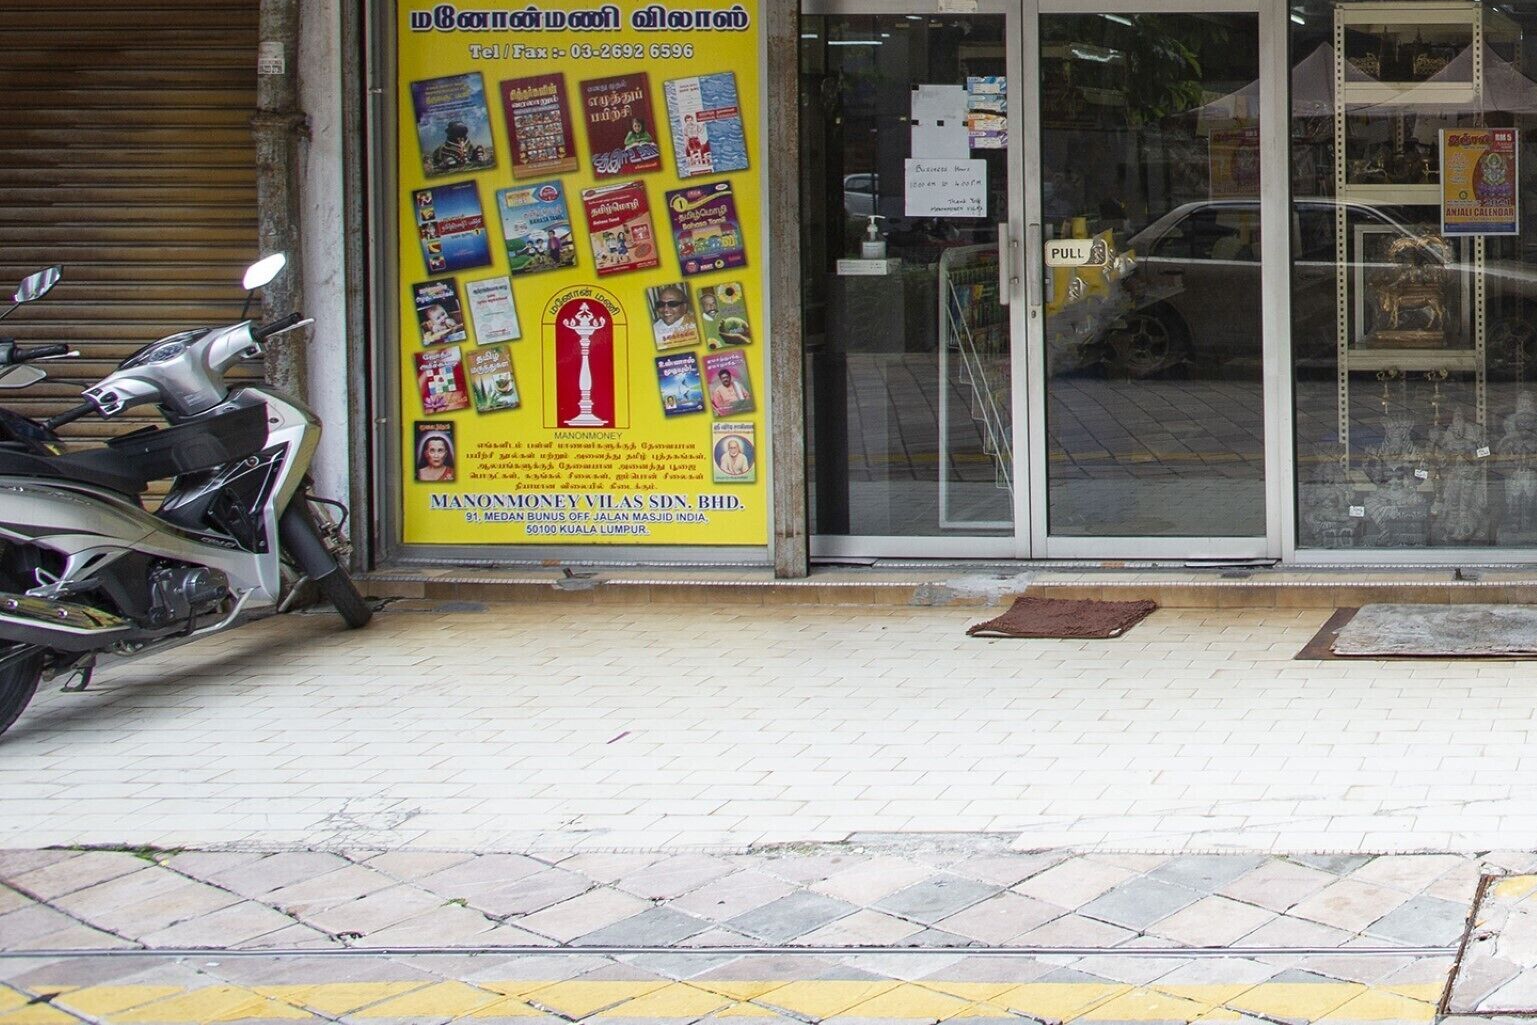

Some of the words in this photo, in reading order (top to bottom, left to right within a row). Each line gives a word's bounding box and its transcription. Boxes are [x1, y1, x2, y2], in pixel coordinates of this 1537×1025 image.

[410, 4, 621, 32] மனோன்மணி
[632, 4, 751, 32] விலாஸ்
[469, 44, 499, 59] Tel
[513, 44, 550, 59] Fax
[570, 44, 644, 60] 03-2692
[649, 43, 694, 59] 6596
[1447, 207, 1472, 217] ANJALI
[1474, 207, 1514, 217] CALENDAR
[1051, 247, 1085, 260] PULL
[555, 432, 623, 440] MANONMONEY
[430, 494, 579, 509] MANONMONEY
[585, 494, 644, 509] VILAS
[649, 494, 692, 509] SDN.
[698, 495, 745, 509] BHD.
[484, 512, 524, 522] MEDAN
[527, 512, 566, 522] BUNUS
[569, 512, 591, 522] OFF
[593, 512, 630, 522] JALAN
[632, 512, 673, 523] MASJID
[526, 524, 556, 535] 50100
[559, 525, 598, 535] KUALA
